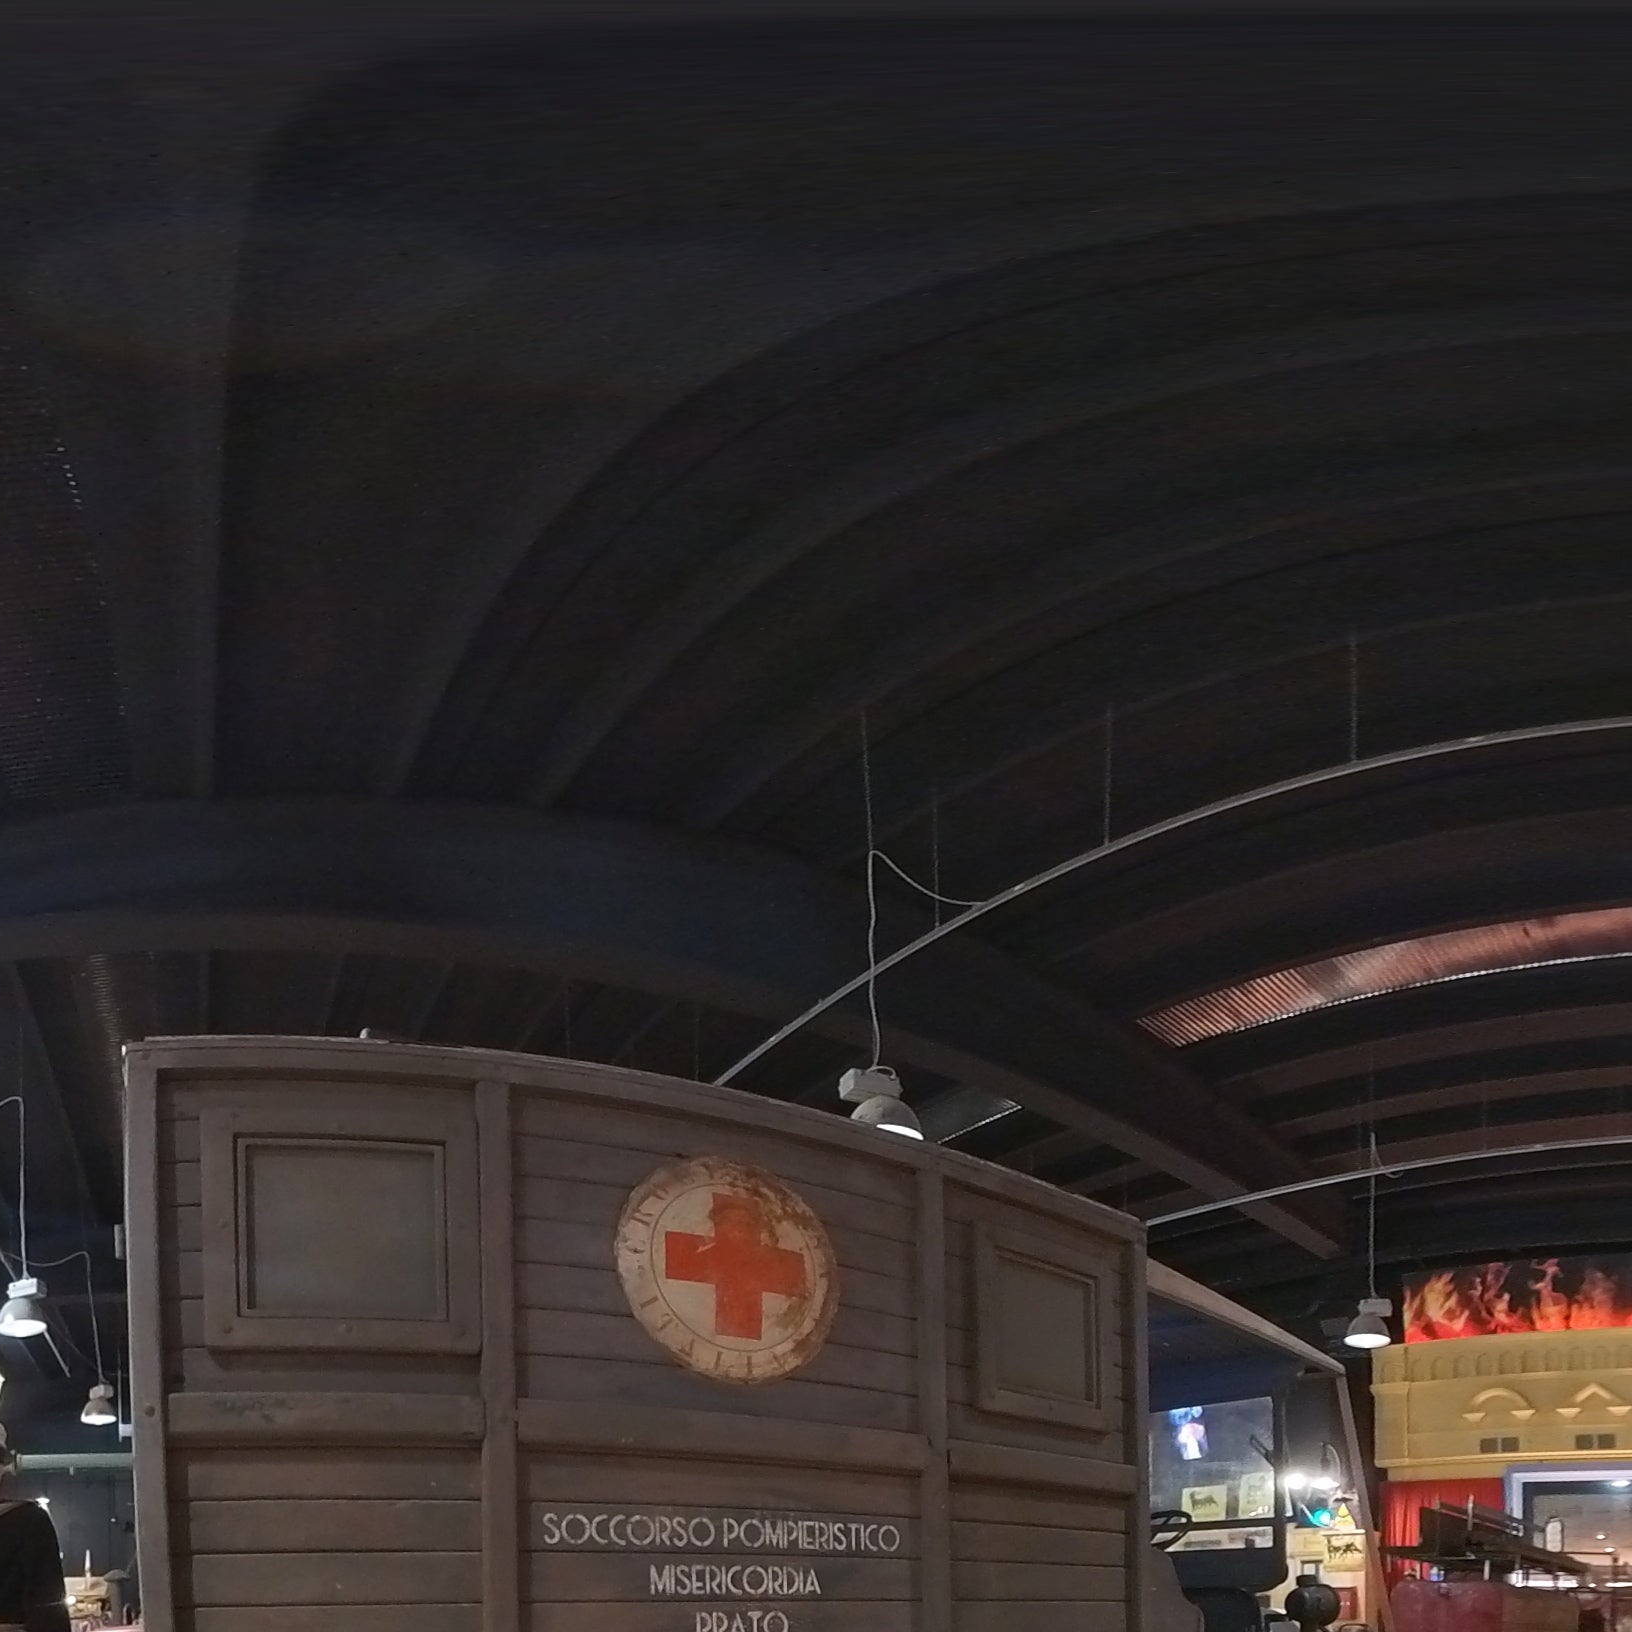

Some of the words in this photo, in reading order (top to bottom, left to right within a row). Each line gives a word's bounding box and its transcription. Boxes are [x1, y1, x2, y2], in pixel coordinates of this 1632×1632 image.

[541, 1512, 716, 1548] SOCCORSO
[722, 1516, 901, 1552] POMPIERISTICO
[649, 1563, 822, 1596] MISERICORDIA
